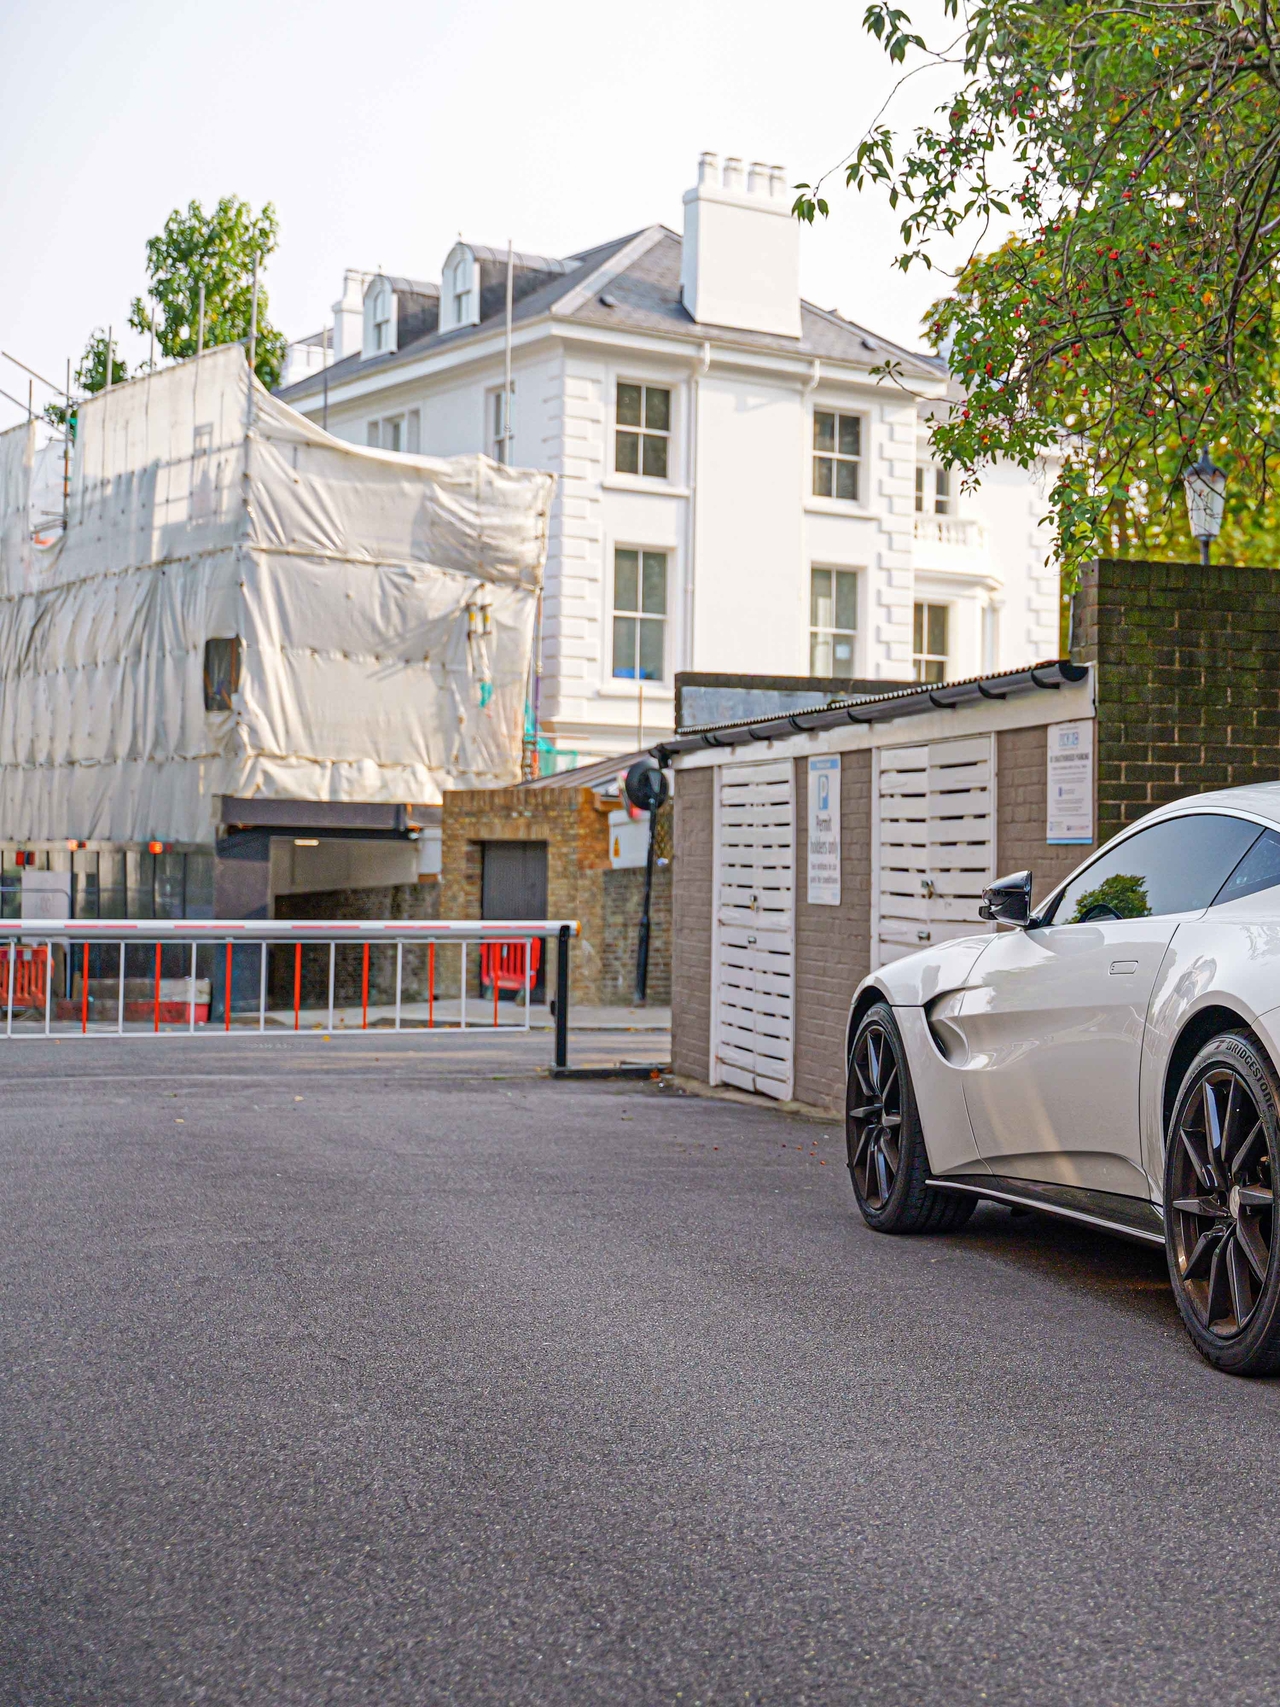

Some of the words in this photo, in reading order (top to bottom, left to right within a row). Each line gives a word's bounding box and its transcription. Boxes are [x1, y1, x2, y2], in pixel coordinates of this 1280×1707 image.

[819, 775, 828, 810] P
[815, 815, 832, 832] Permit
[1226, 1041, 1276, 1112] BRIDGESTONE
